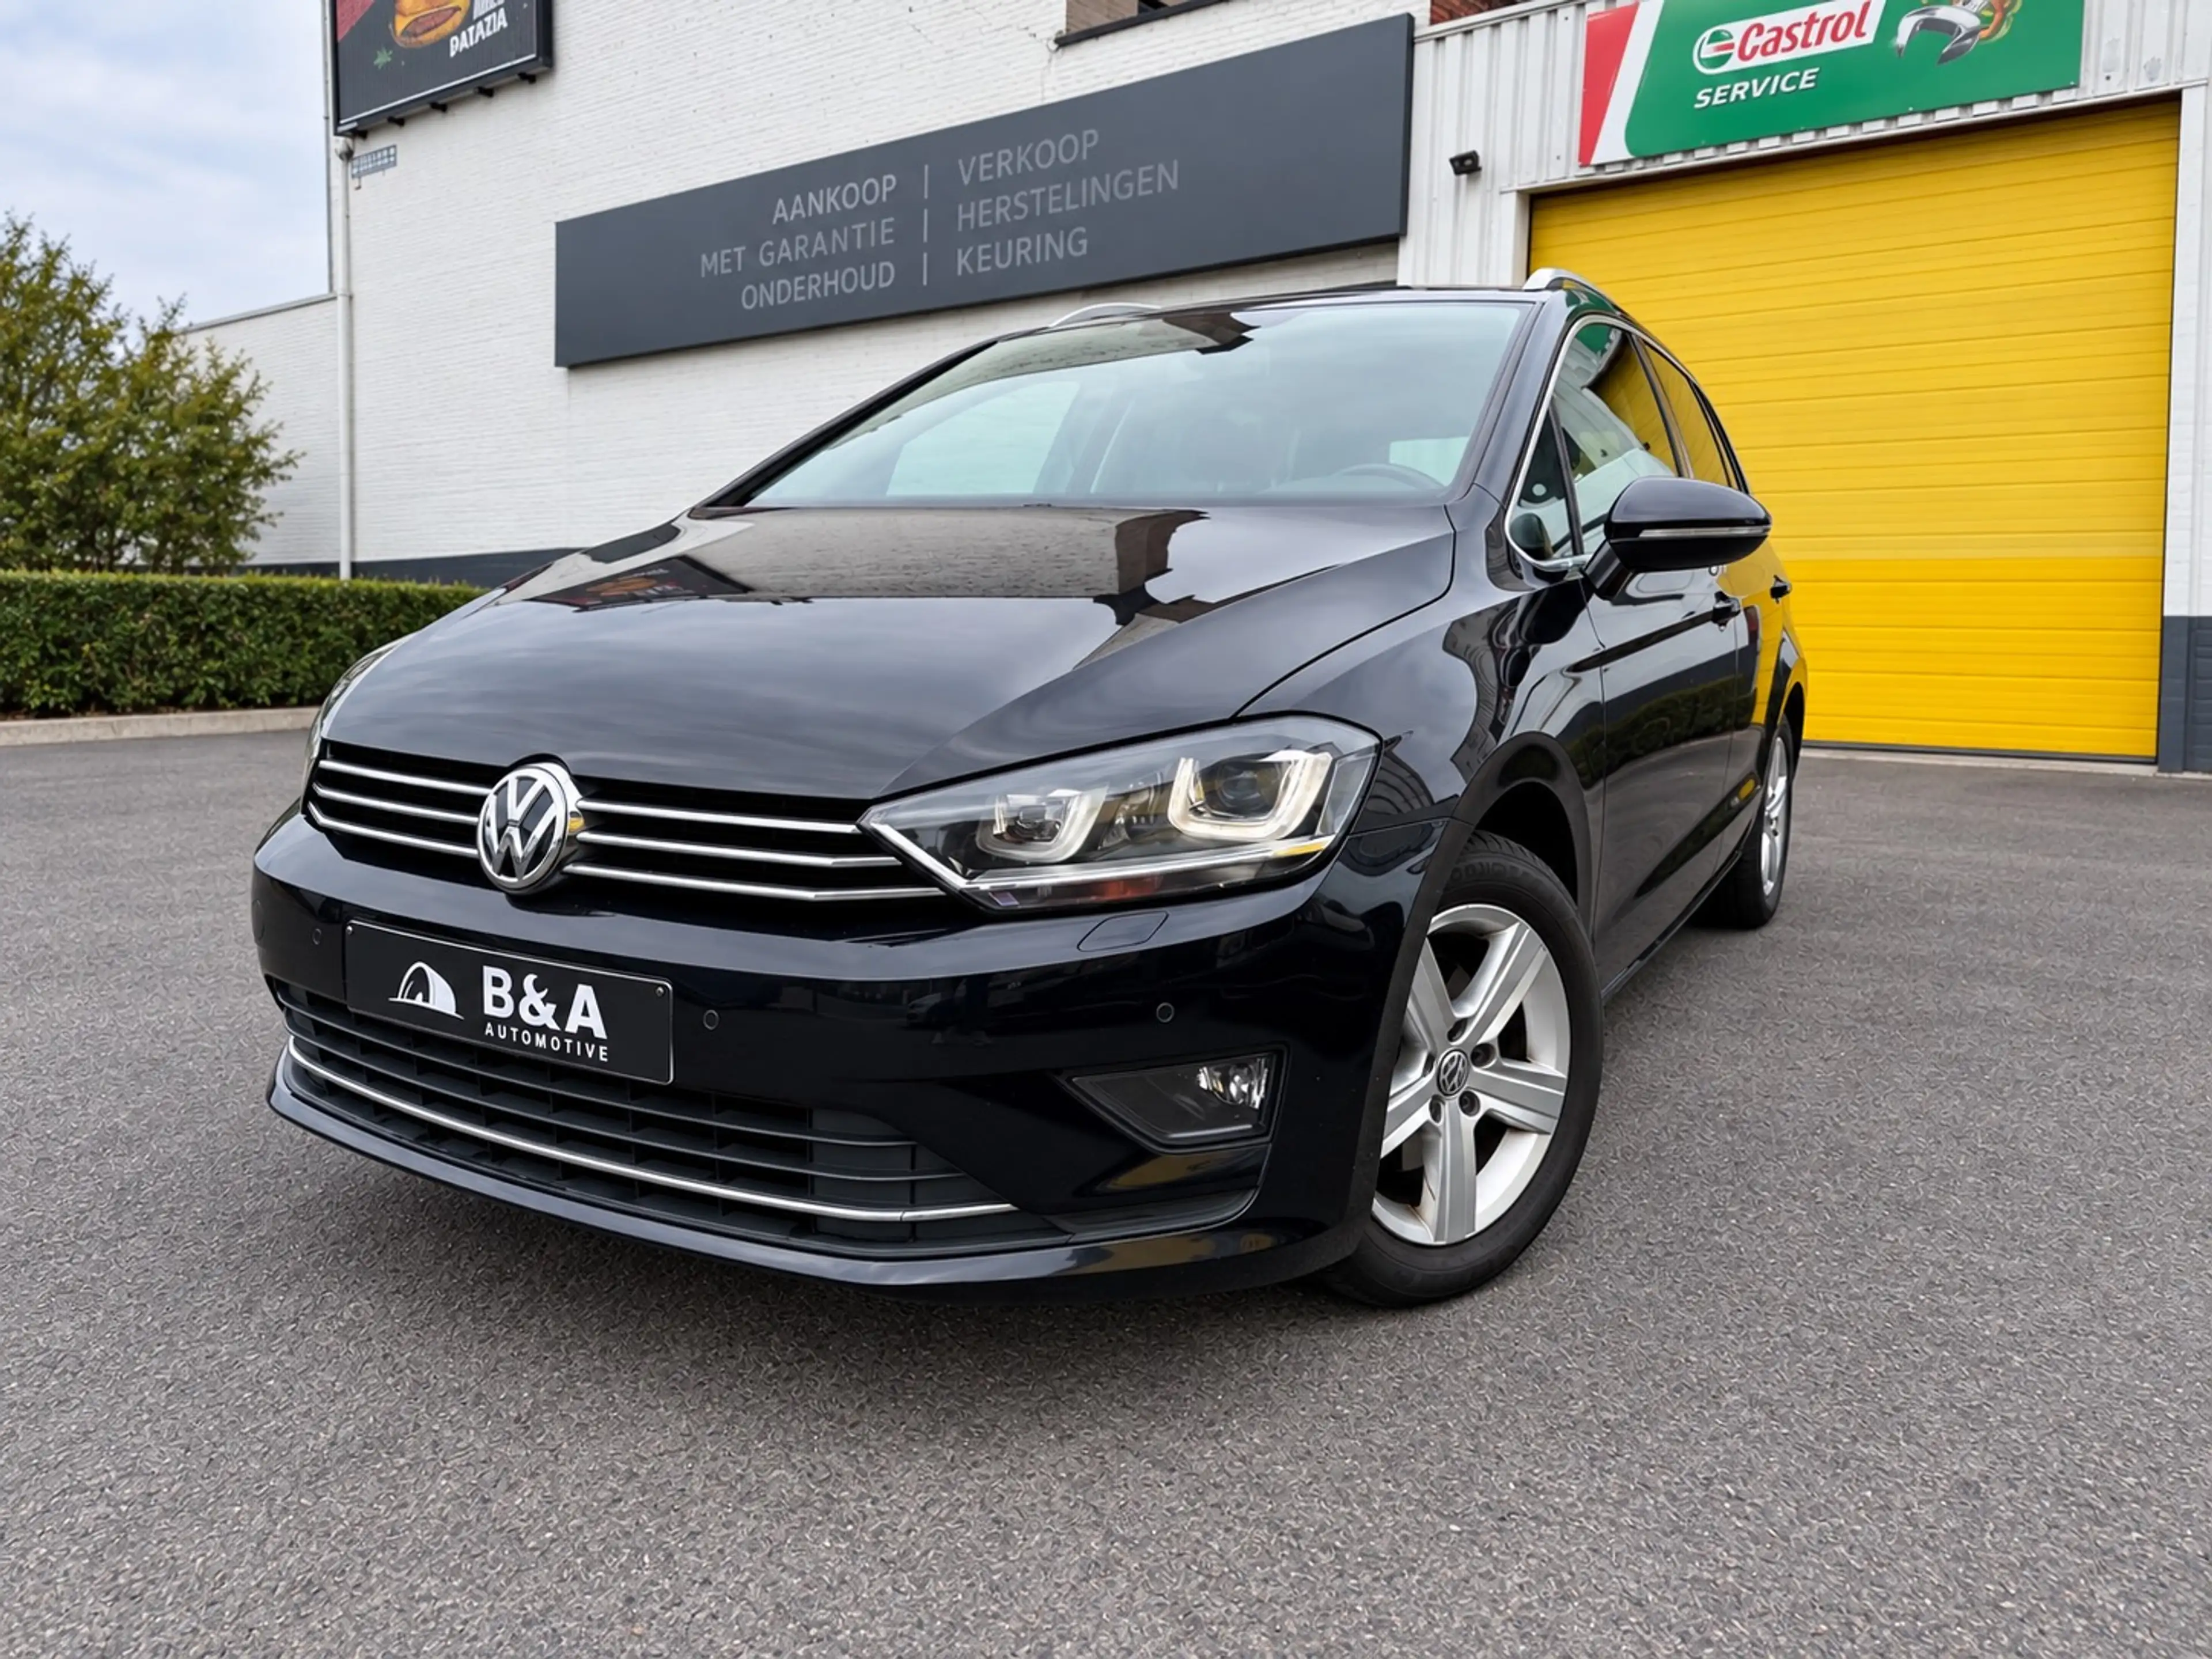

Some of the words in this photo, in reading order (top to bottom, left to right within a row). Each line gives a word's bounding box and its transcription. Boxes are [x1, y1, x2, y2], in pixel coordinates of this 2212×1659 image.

[1737, 0, 1871, 62] Castrol
[1694, 67, 1820, 108] SERVICE
[773, 174, 897, 225] AANKOOP
[959, 129, 1099, 185] VERKOOP
[700, 247, 745, 278] MET
[759, 218, 895, 267] GARANTIE
[957, 160, 1179, 232] HERSTELINGEN
[741, 261, 895, 310] ONDERHOUD
[957, 227, 1087, 276] KEURING
[482, 965, 607, 1039] B&A
[484, 1022, 609, 1063] AUTOMOTIVE
